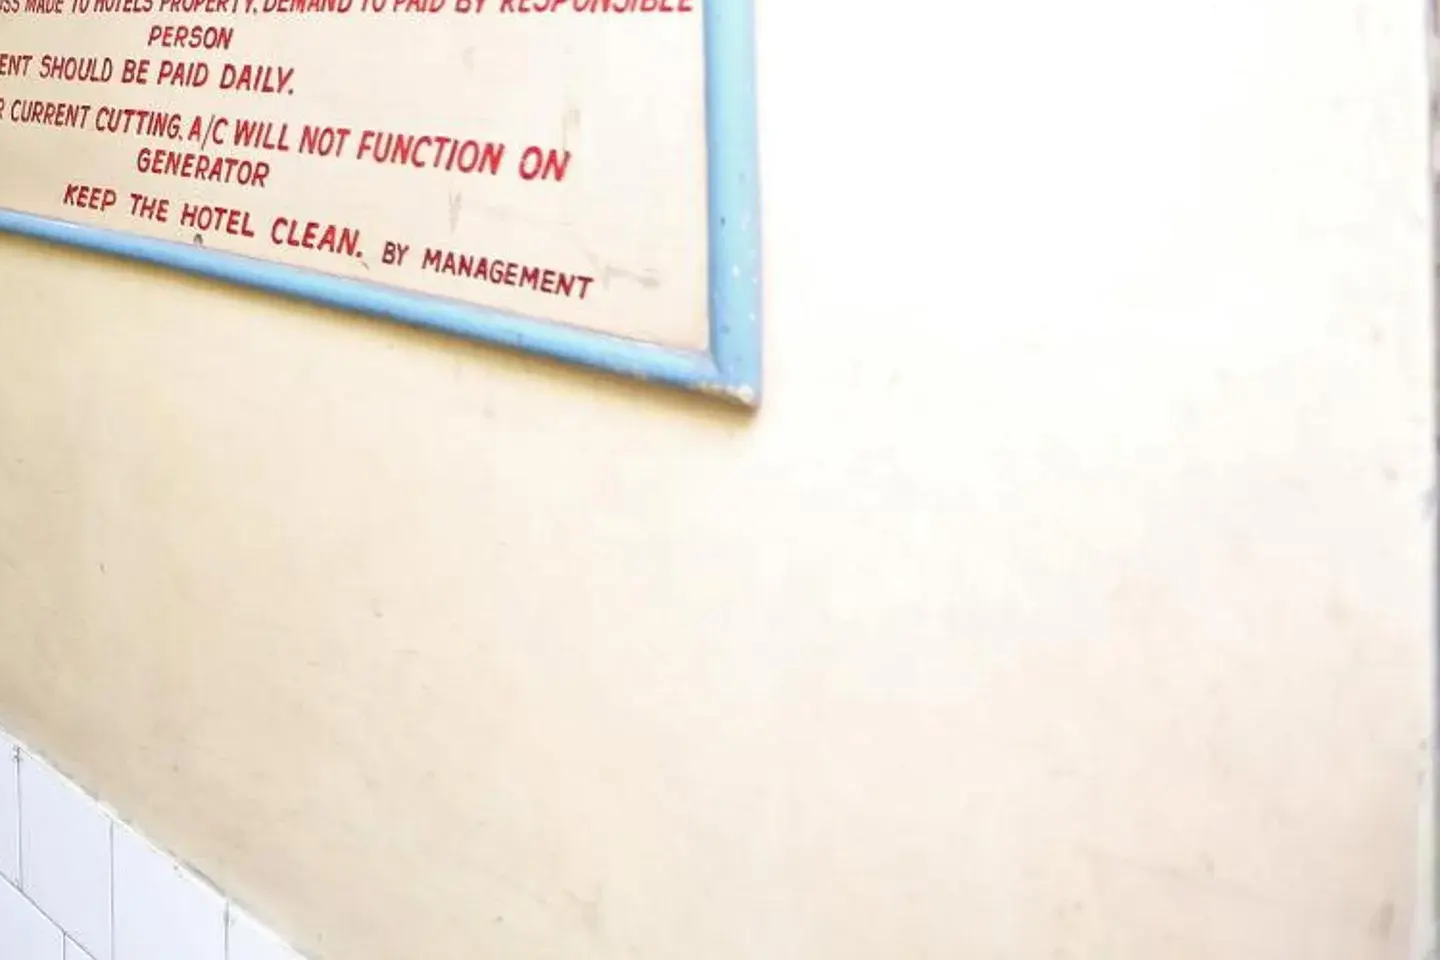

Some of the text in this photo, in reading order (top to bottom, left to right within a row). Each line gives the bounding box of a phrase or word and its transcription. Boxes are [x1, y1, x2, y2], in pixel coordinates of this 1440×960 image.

[146, 24, 235, 51] PERSON
[38, 53, 114, 84] SHOULD
[120, 58, 151, 86] BE
[156, 59, 210, 89] PAID
[218, 62, 295, 96] DAILY.
[9, 98, 92, 130] CURRENT
[186, 113, 230, 151] A/C
[233, 118, 291, 153] WILL
[297, 124, 352, 159] NOT
[355, 129, 507, 177] FUNCTION
[517, 144, 573, 183] ON
[136, 146, 271, 189] GENERATOR
[62, 182, 118, 213] KEEP
[129, 192, 171, 224] THE
[179, 202, 256, 239] HOTEL
[269, 216, 364, 259] CLEAN.
[380, 239, 411, 267] BY
